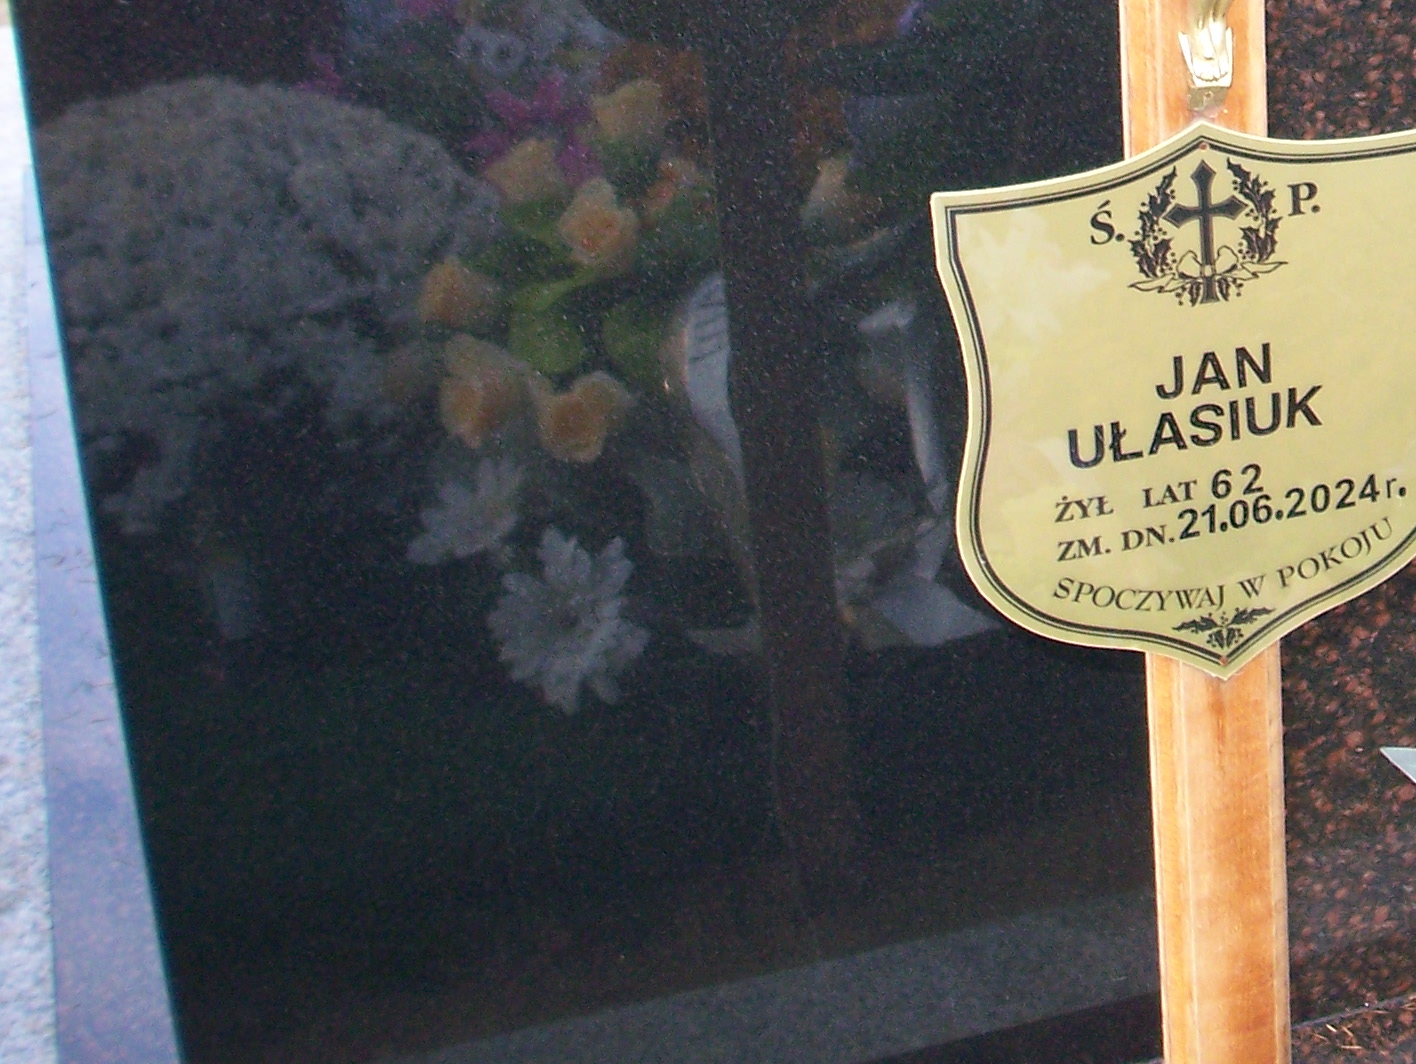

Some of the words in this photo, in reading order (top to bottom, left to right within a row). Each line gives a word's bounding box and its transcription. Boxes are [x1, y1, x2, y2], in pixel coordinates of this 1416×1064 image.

[1155, 342, 1273, 400] JAN
[1067, 385, 1324, 469] UŁASIUK
[1054, 495, 1114, 523] ŻYŁ
[1142, 479, 1198, 508] LAT
[1211, 463, 1264, 499] 62
[1053, 577, 1226, 612] SPOCZYWAJ
[1237, 573, 1267, 599] W
[1276, 516, 1393, 589] POKOJU
[1057, 535, 1112, 562] ZM.
